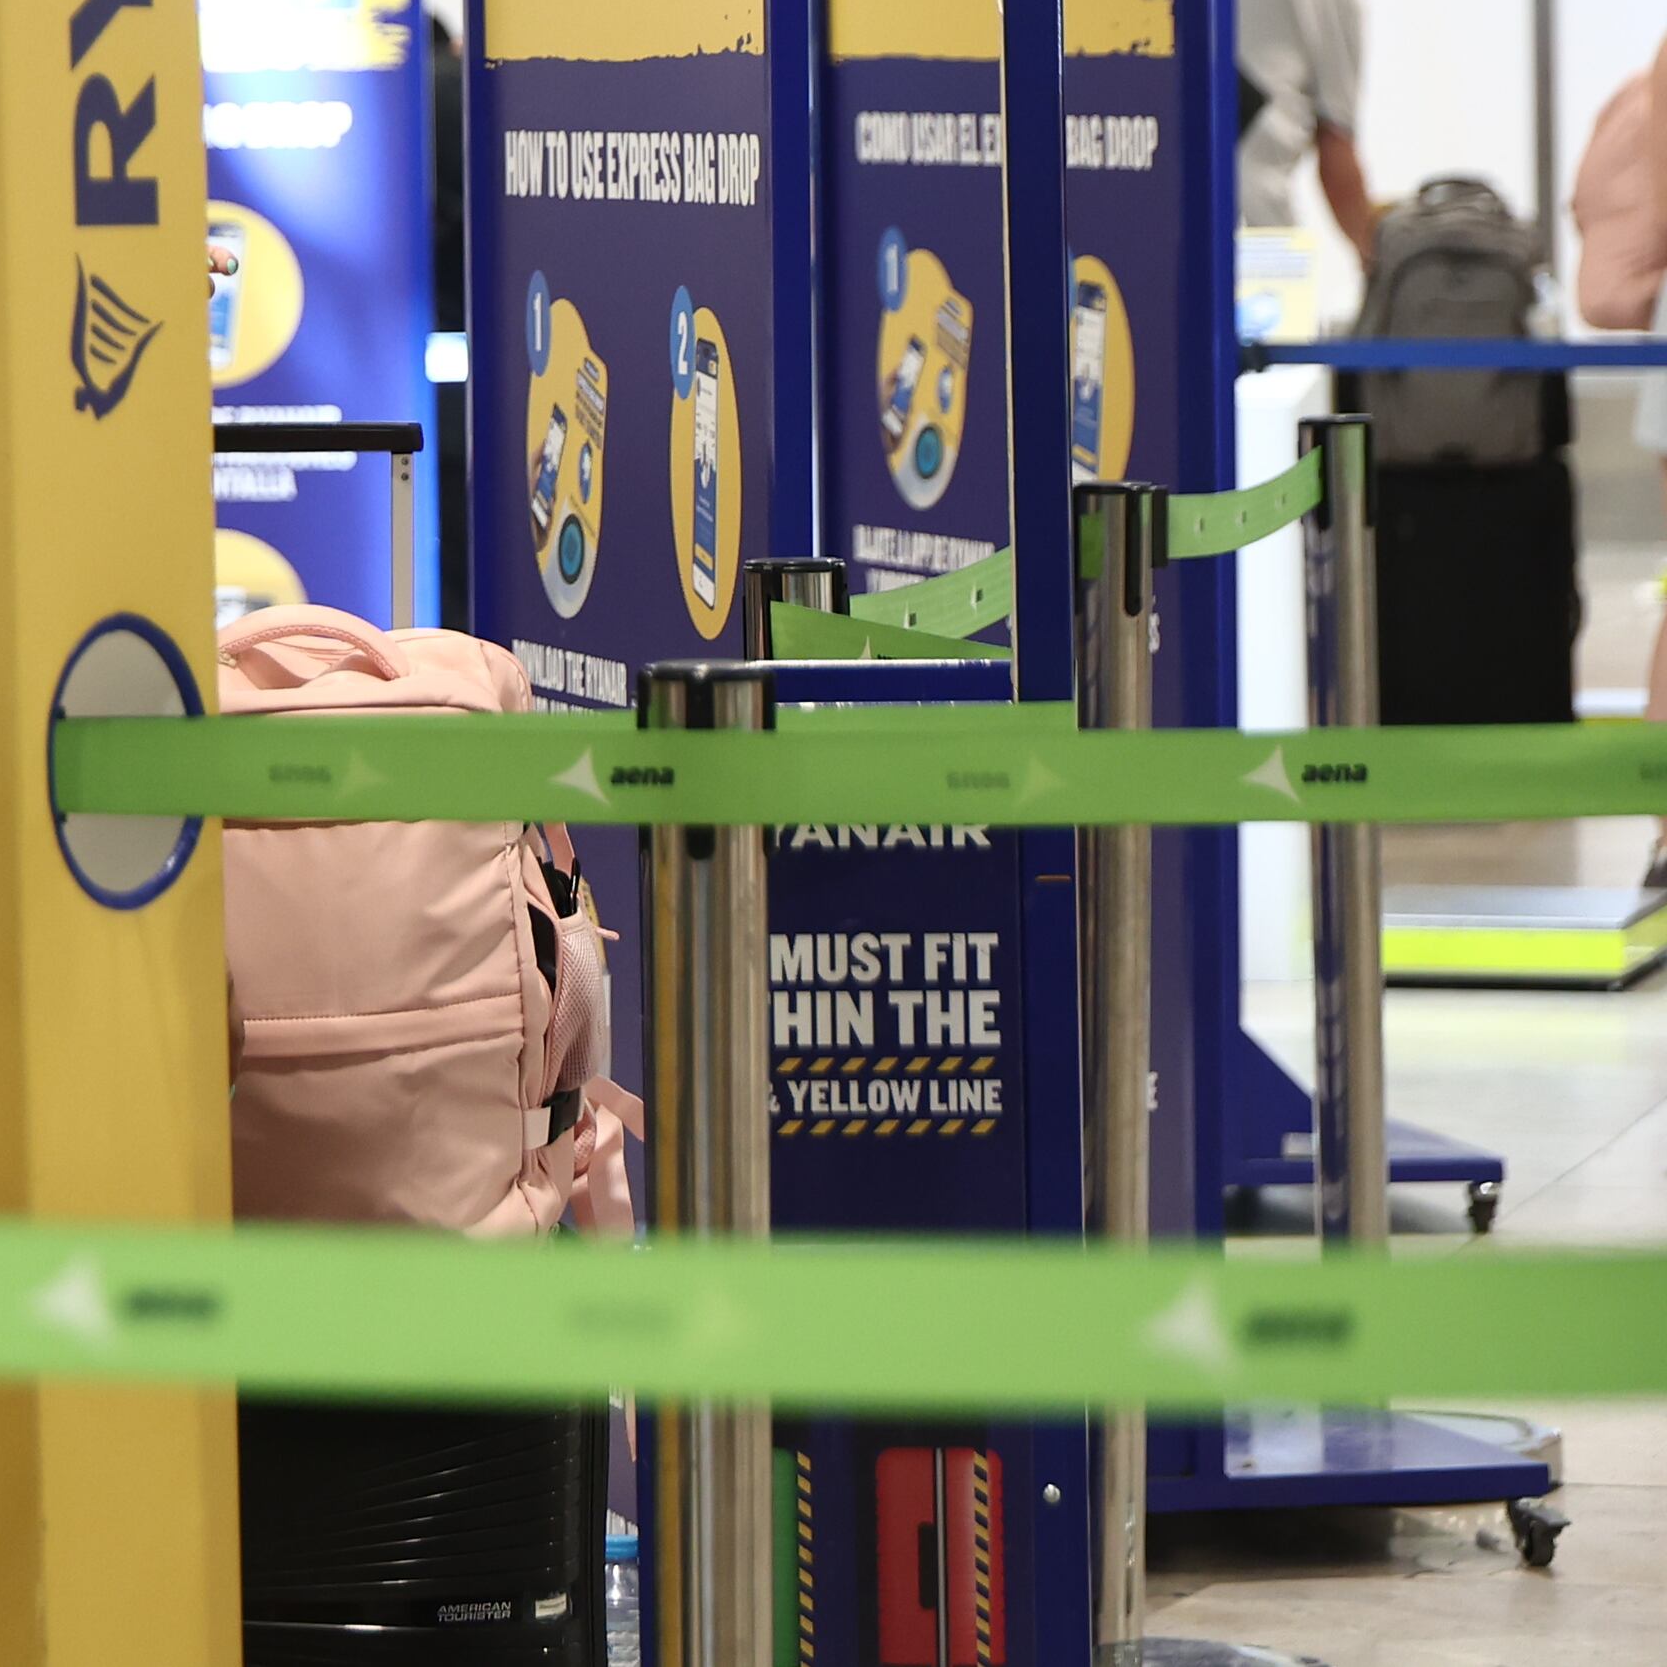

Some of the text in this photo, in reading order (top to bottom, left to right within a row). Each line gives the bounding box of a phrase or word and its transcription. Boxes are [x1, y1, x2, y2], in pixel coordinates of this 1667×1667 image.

[505, 130, 760, 206] HOW TO USE EXPRESS BAG DROP
[1105, 115, 1159, 171] DROP
[532, 292, 542, 352] 1
[678, 311, 688, 375] 2
[611, 766, 675, 786] aena
[1301, 761, 1368, 784] aena
[770, 933, 999, 983] MUST FIT
[767, 990, 1001, 1047] HIN THE
[787, 1080, 922, 1113] YELLOW
[929, 1079, 1002, 1113] LINE
[438, 1600, 511, 1614] AMERICAN
